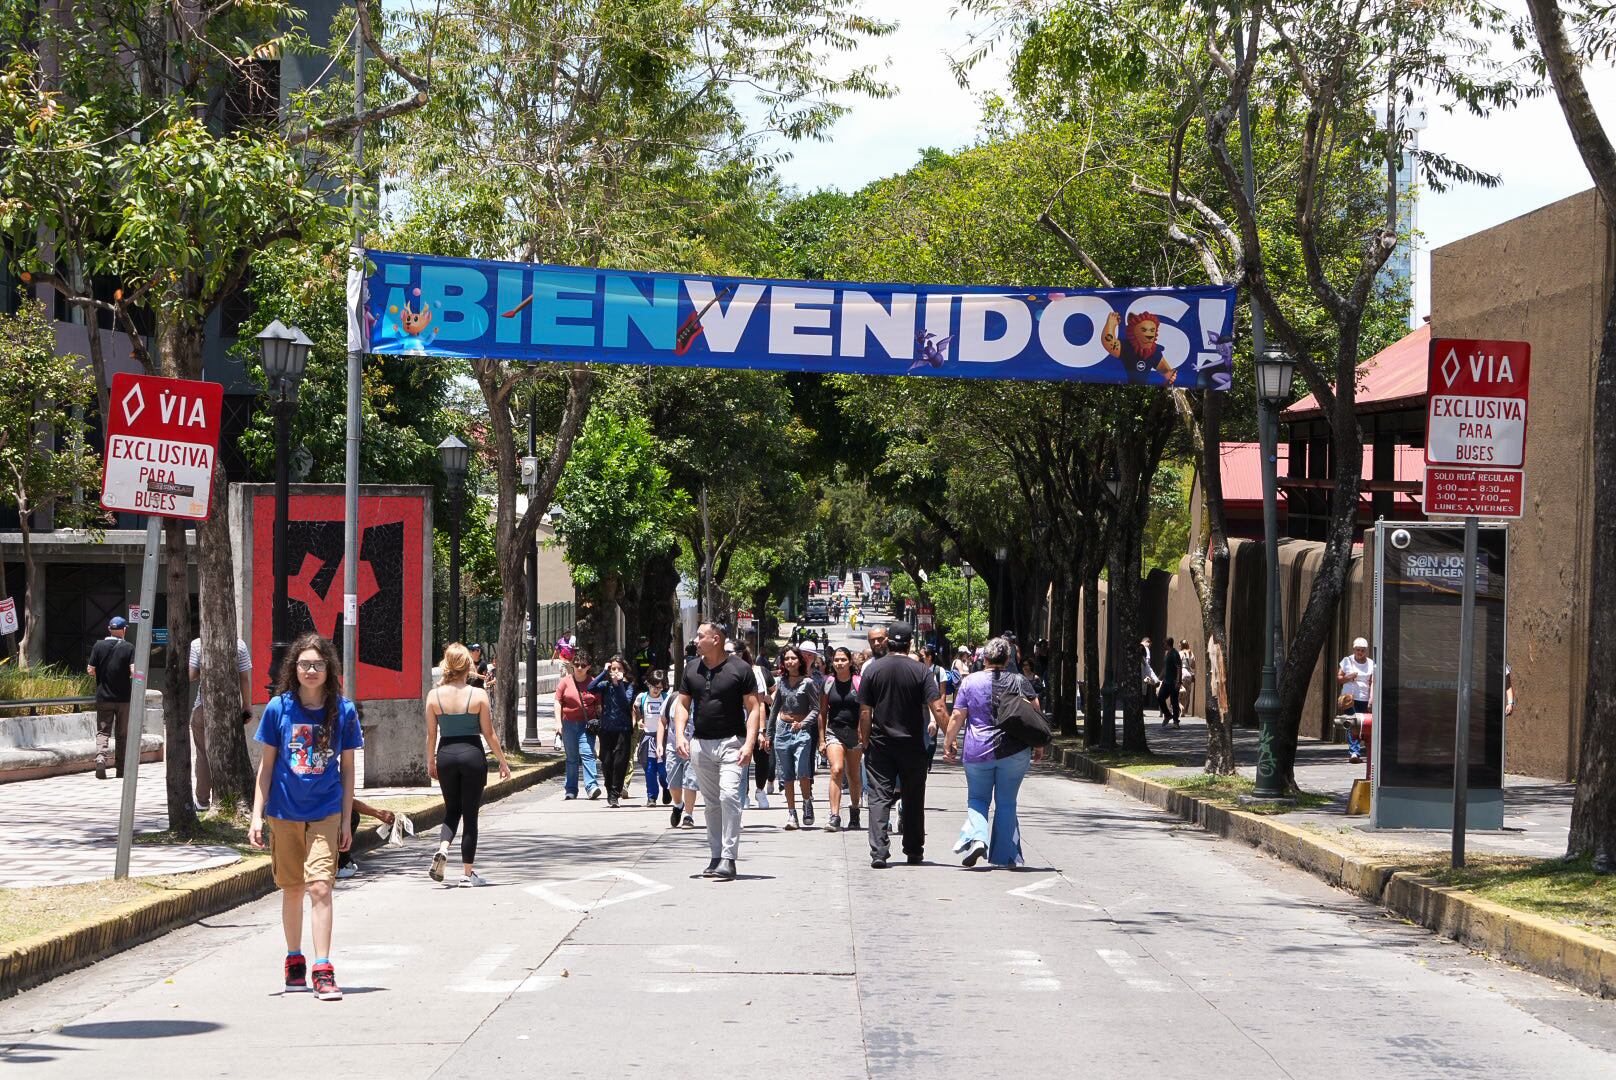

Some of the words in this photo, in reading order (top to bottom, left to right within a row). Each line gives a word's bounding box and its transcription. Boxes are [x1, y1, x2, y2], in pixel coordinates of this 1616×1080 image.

[1469, 355, 1514, 383] VIA
[159, 393, 206, 429] VIA
[1433, 398, 1522, 421] EXCLUSIVA
[1458, 422, 1493, 439] PARA
[112, 438, 209, 469] EXCLUSIVA
[1456, 444, 1494, 461] BUSES
[139, 466, 176, 485] PARA
[1434, 472, 1455, 480] SOLO
[1456, 473, 1476, 481] RUTA
[1478, 474, 1515, 482] REGULAR
[1437, 483, 1457, 491] 6:00
[1479, 485, 1499, 493] 8:30
[134, 490, 177, 511] BUSES
[1436, 493, 1456, 501] 3:00
[1479, 494, 1499, 502] 7:00
[1434, 503, 1463, 511] LUNES
[1475, 505, 1514, 513] VIERNES
[1407, 555, 1439, 568] S@N
